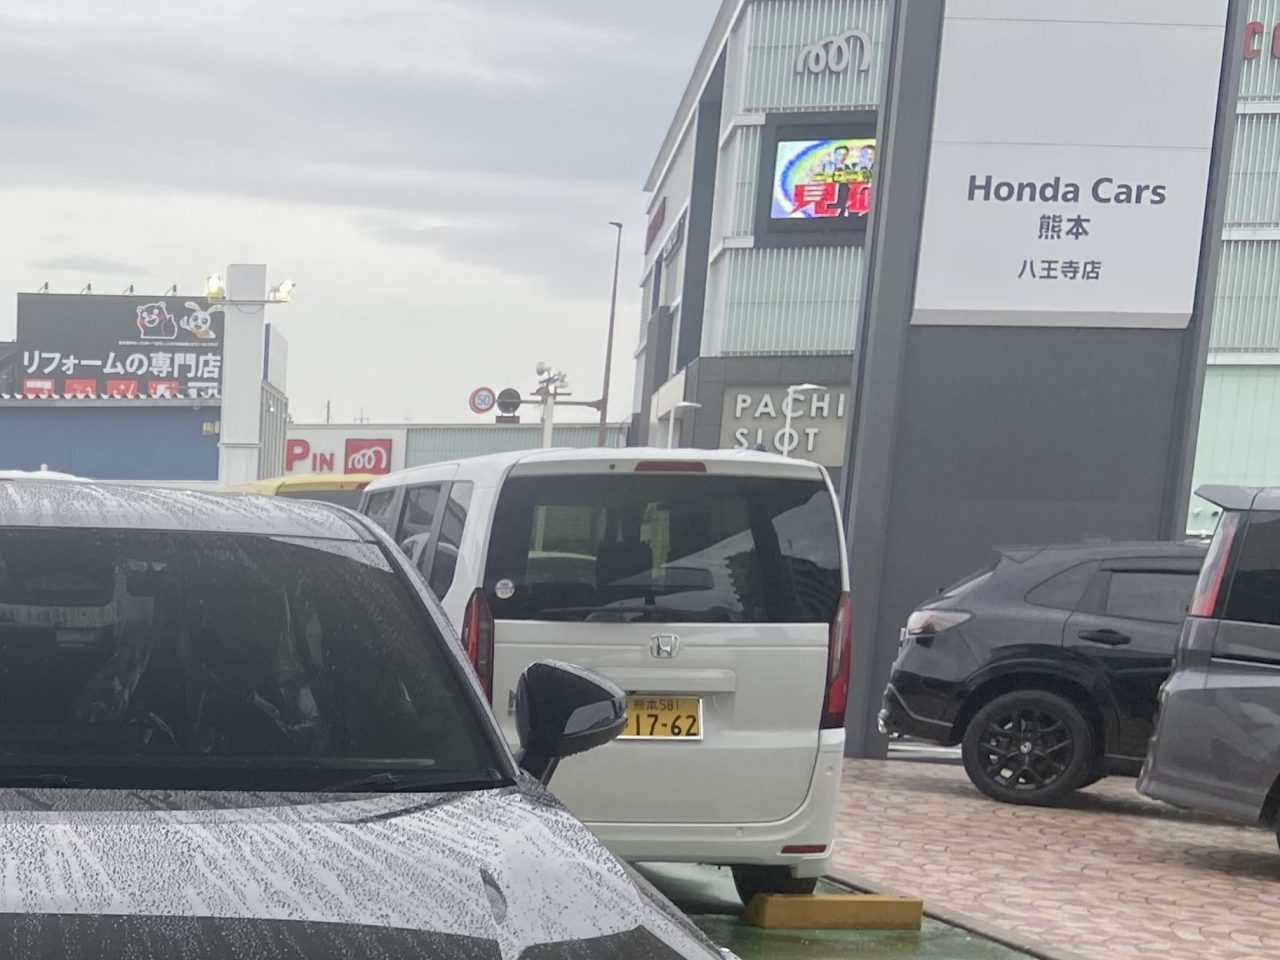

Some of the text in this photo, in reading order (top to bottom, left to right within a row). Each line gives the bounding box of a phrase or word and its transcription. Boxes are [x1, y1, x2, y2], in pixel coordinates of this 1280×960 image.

[968, 175, 1167, 205] Honda Cars
[1038, 214, 1091, 240] 熊本
[1017, 259, 1102, 280] 八王寺店
[23, 351, 222, 379] リフォームの専門店
[477, 394, 491, 406] 50
[735, 393, 845, 418] PACHI
[635, 714, 697, 736] 17-62
